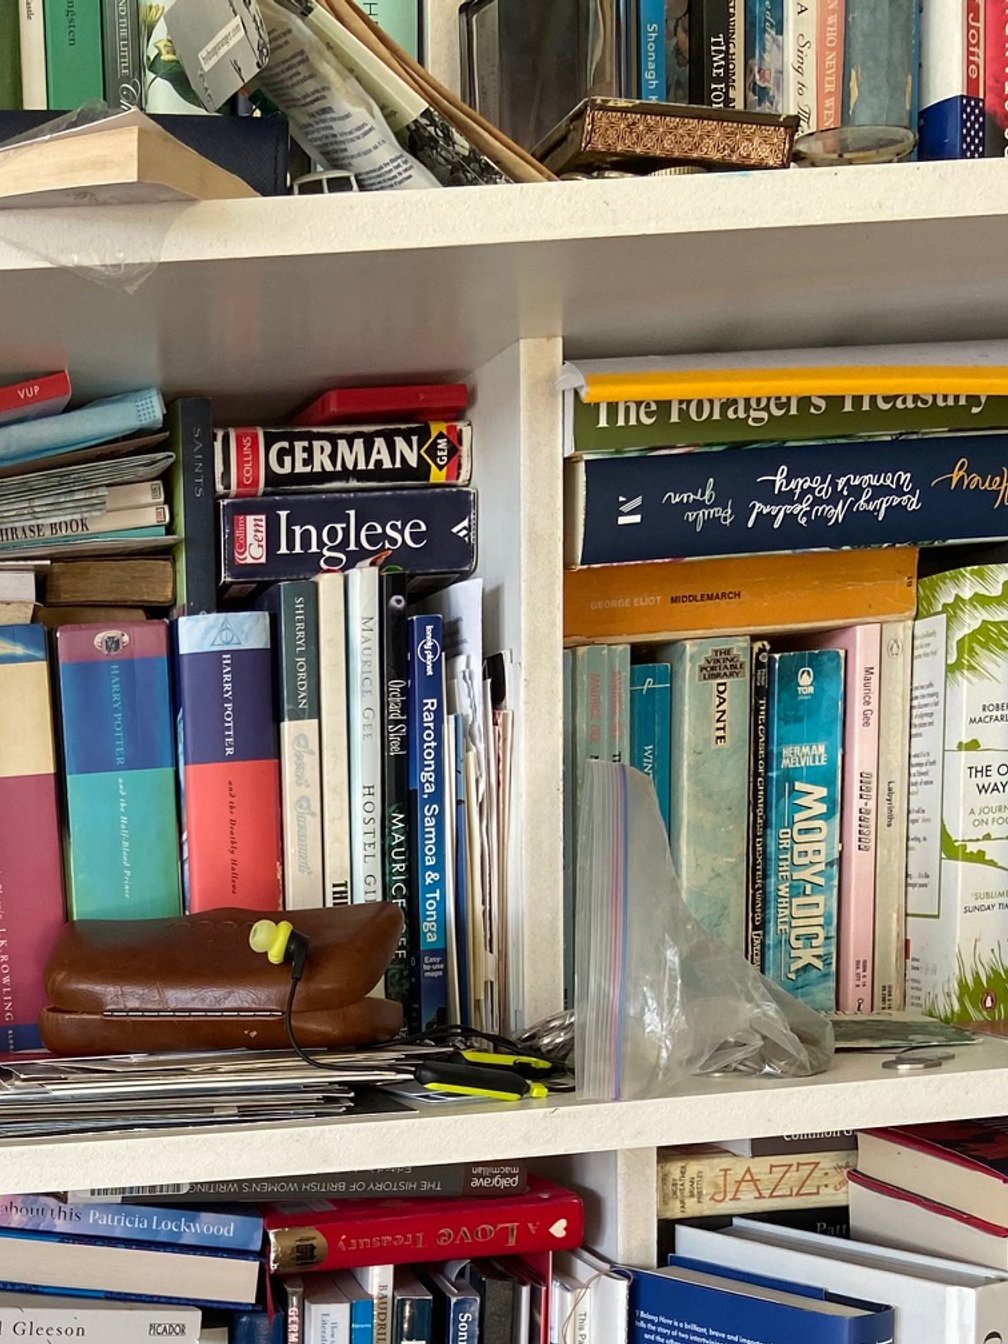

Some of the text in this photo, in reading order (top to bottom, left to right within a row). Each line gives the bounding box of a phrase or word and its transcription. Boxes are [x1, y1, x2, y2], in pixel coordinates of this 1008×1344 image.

[646, 23, 659, 90] Shonagh
[968, 14, 983, 80] Joffe
[17, 385, 41, 400] VUP
[193, 427, 203, 498] SAINTS
[243, 436, 253, 484] COLLINS
[268, 435, 419, 474] GERMAN
[437, 438, 447, 464] GEM
[49, 517, 90, 533] BOOK
[276, 510, 427, 570] Inglese
[670, 590, 741, 605] MIDDLEMARCH
[295, 597, 308, 709] SHERRYL JORDAN
[361, 616, 373, 697] MAURICE
[699, 663, 746, 673] PORTABLE
[222, 655, 235, 756] HARRY POTTER
[863, 667, 874, 707] Maurice
[715, 682, 727, 746] DANTE
[781, 755, 828, 767] MELVILLE
[782, 744, 825, 758] HERMAN
[422, 698, 439, 943] Rarotonga, Samoa Tonga
[886, 781, 896, 827] Labyrinths
[776, 883, 789, 935] WHALE
[188, 1182, 302, 1193] WOMEN'S WRITING
[369, 1181, 414, 1191] HISTORY
[470, 1175, 518, 1189] palgrave
[88, 1209, 234, 1238] Patricia Lockwood
[337, 1232, 424, 1251] Treasury
[12, 1320, 86, 1337] Gleeson
[149, 1324, 186, 1336] PICADOR
